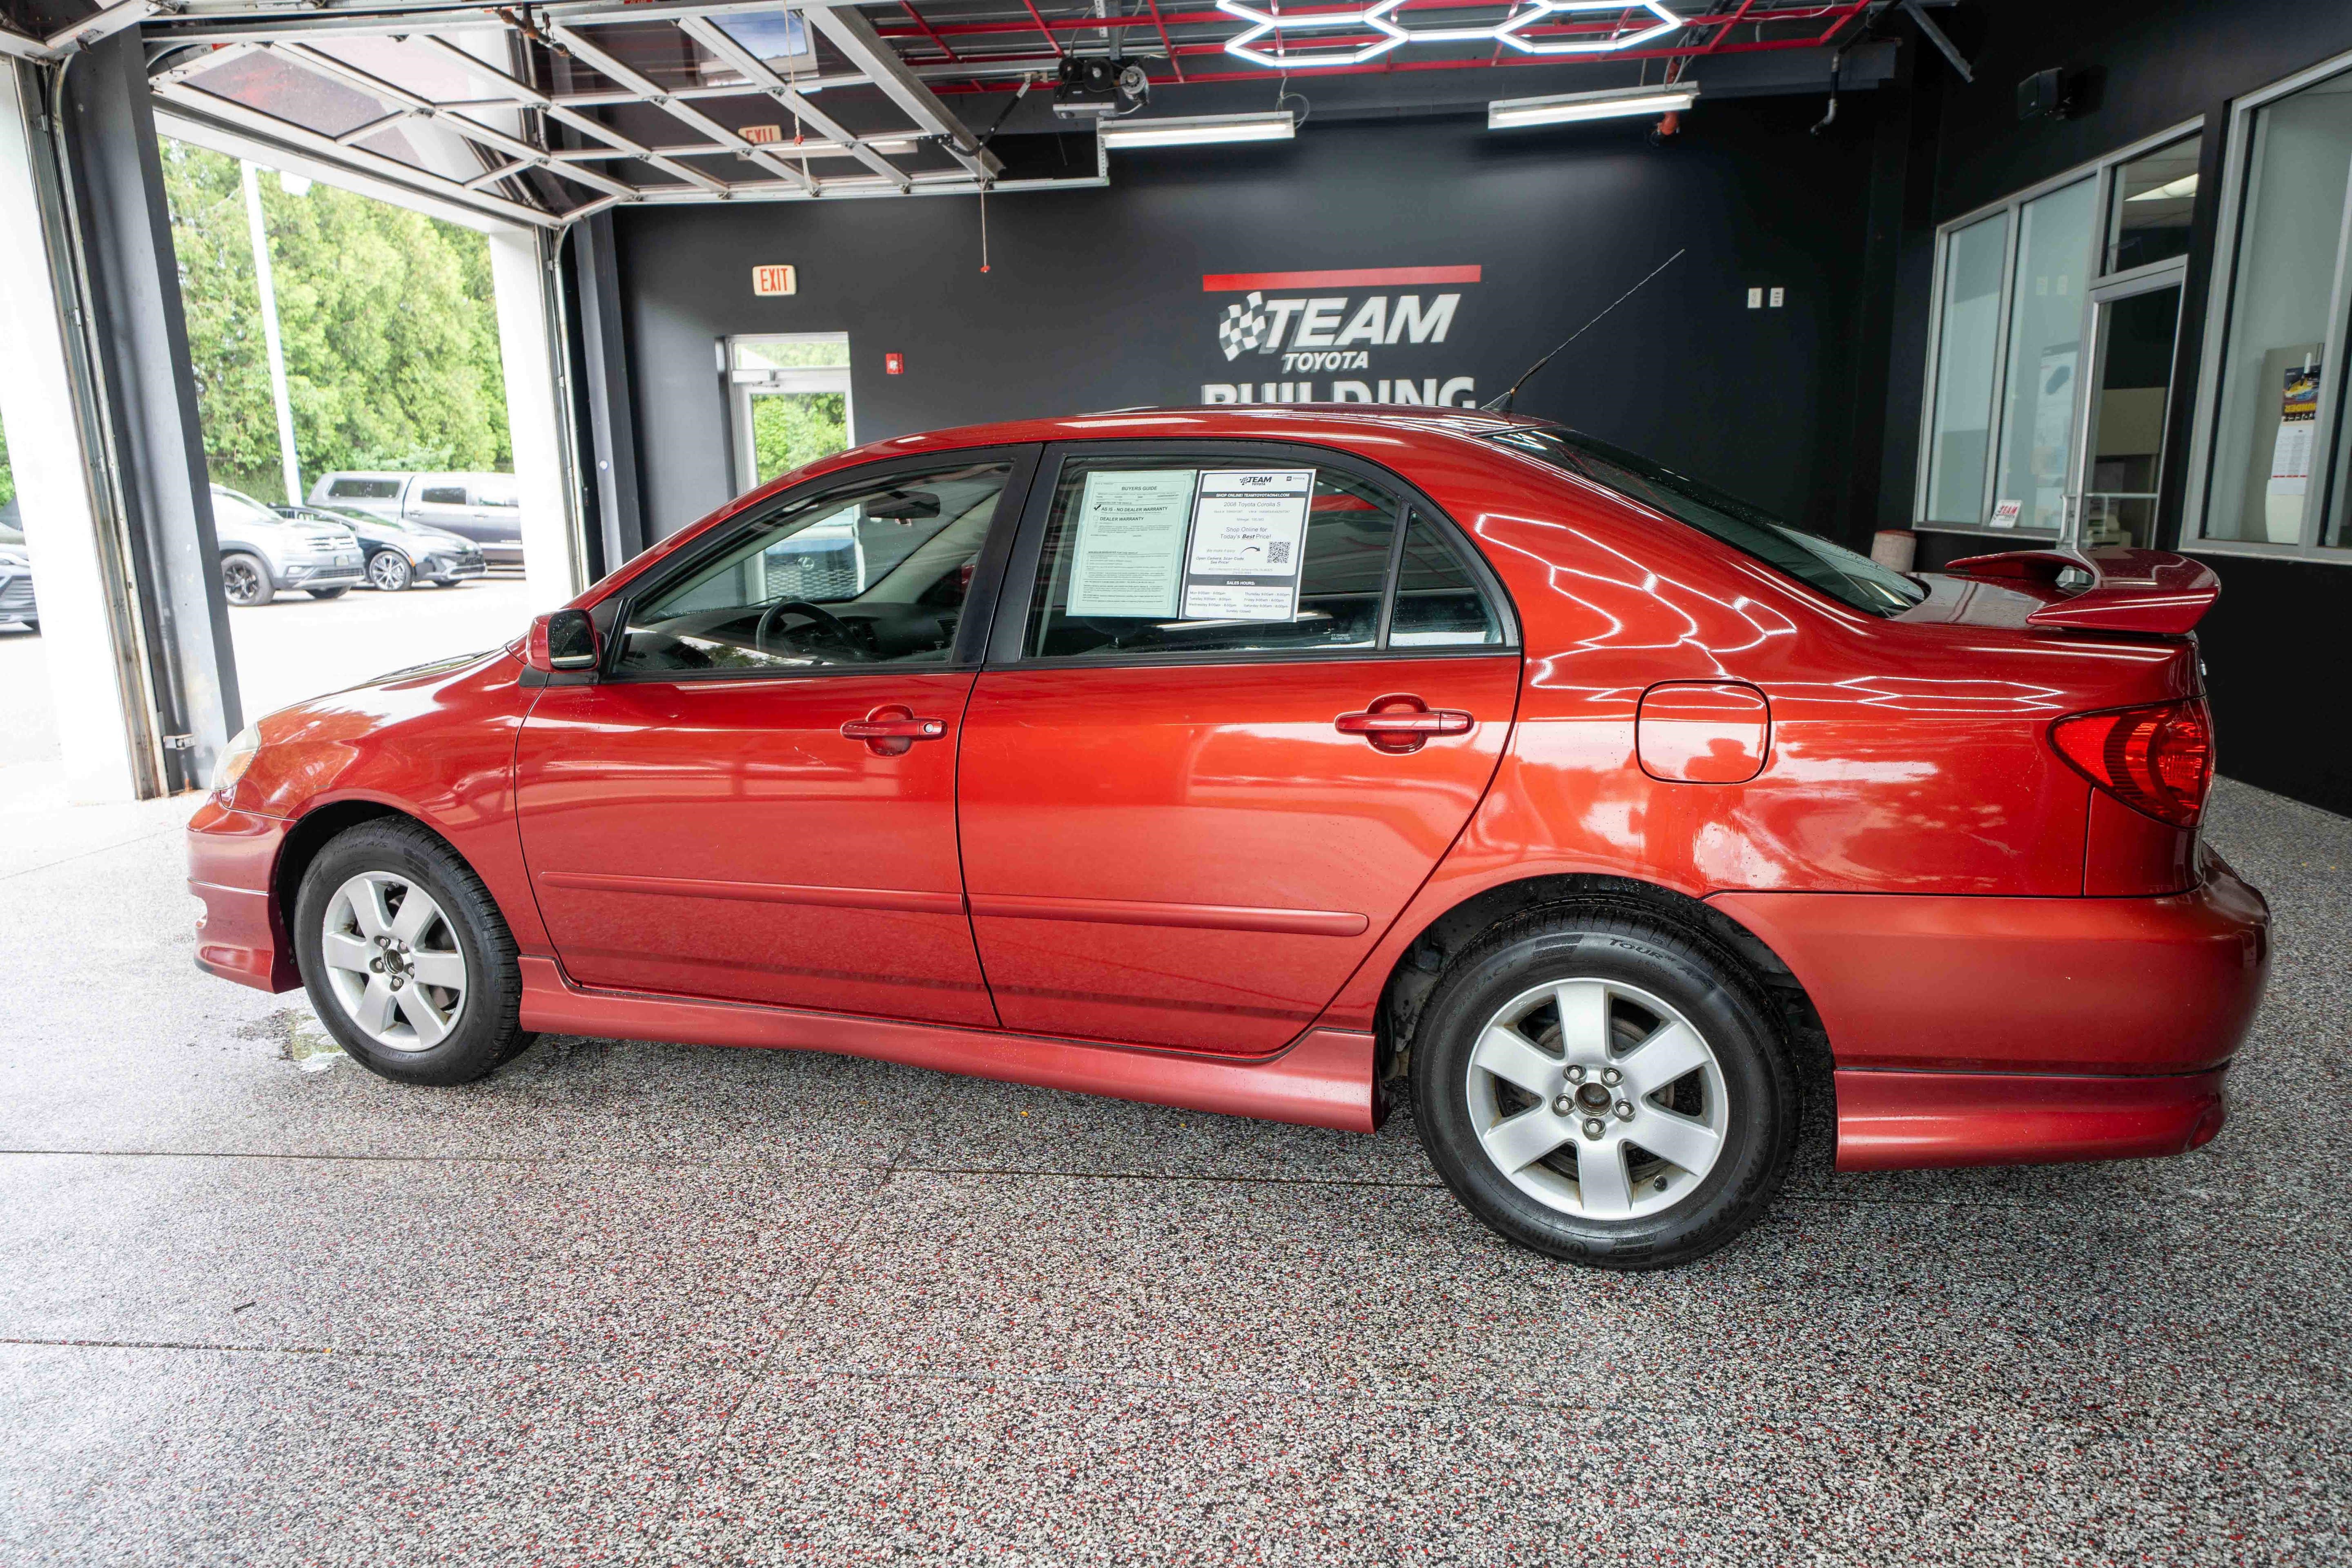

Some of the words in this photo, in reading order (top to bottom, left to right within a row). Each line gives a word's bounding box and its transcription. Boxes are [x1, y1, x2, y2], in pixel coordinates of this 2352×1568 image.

[760, 268, 788, 292] EXIT
[1263, 293, 1461, 350] TEAM
[1283, 351, 1369, 372] TOYOTA
